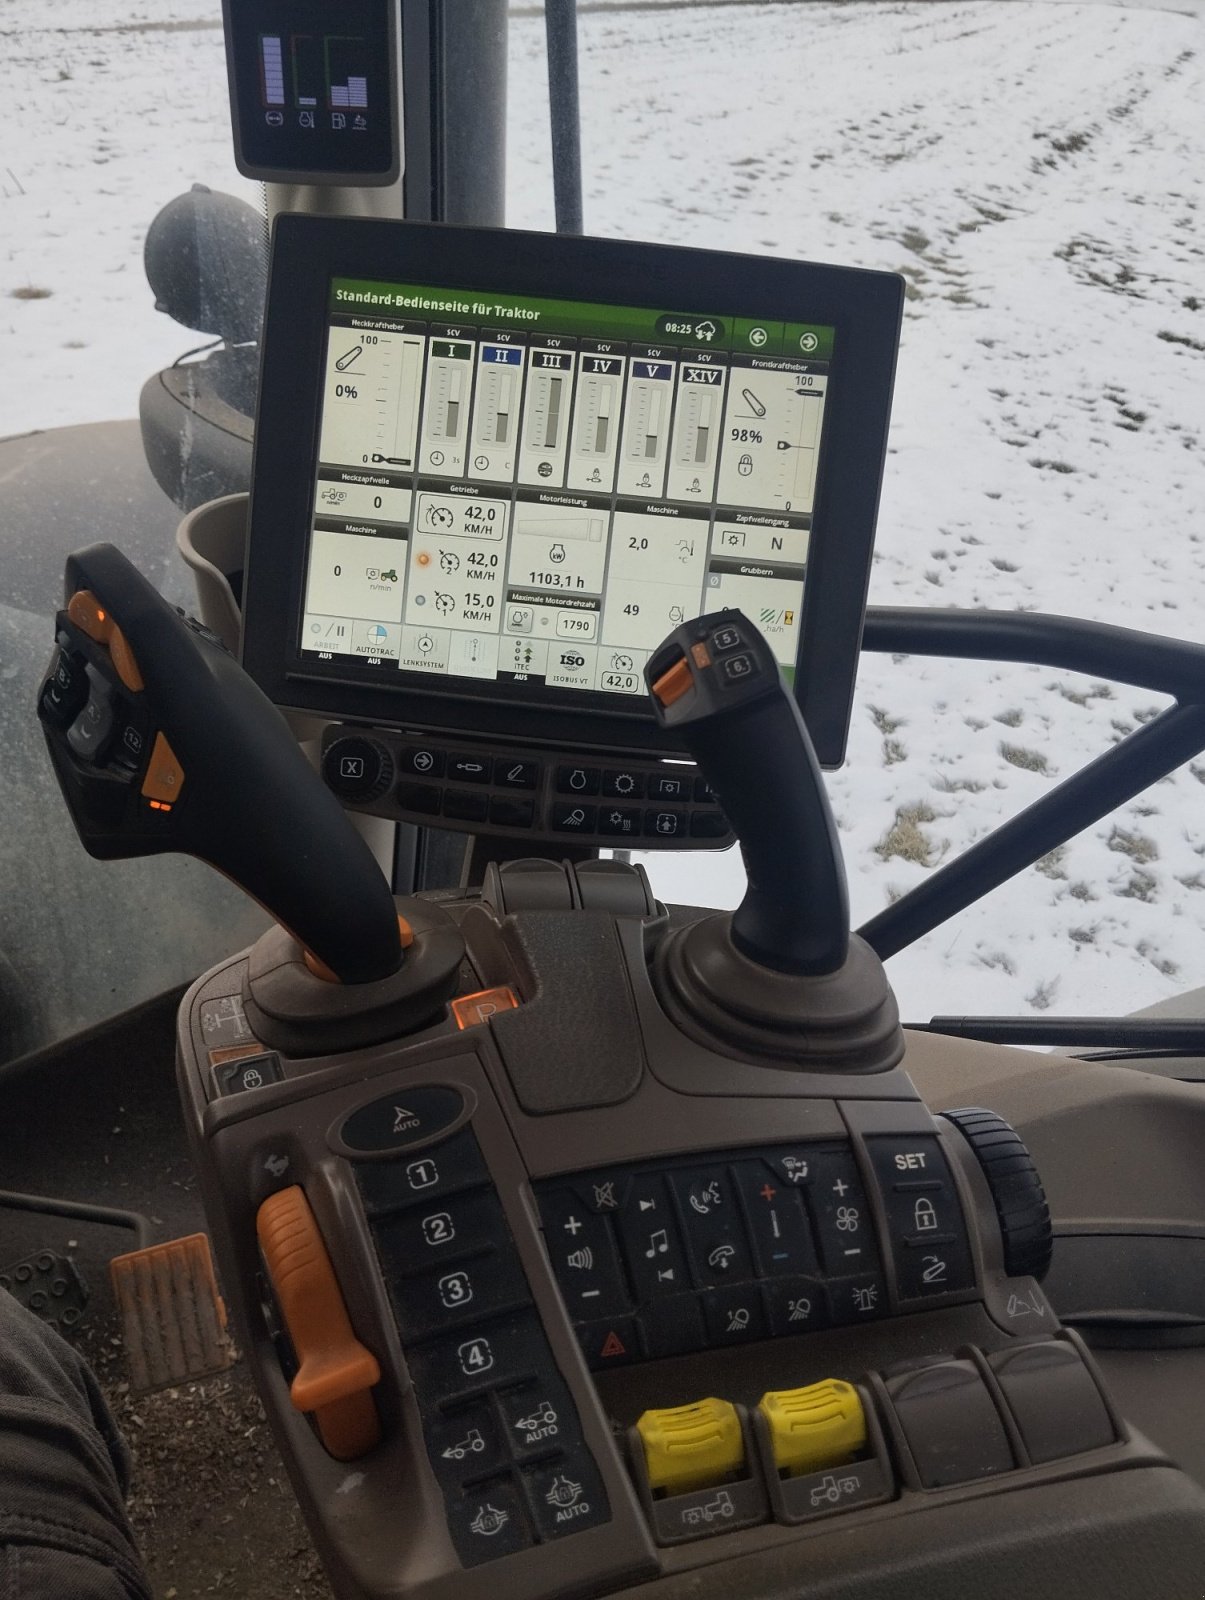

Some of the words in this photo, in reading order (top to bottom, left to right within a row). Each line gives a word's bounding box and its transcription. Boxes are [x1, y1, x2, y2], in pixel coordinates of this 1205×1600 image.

[336, 289, 469, 314] Standard-Bedienseite
[472, 303, 492, 316] für
[495, 306, 540, 320] Traktor
[352, 319, 404, 331] Heckkraftheber
[665, 323, 691, 334] 08:25
[447, 329, 460, 337] SCV
[497, 334, 510, 342] SCV
[360, 335, 378, 345] 100
[547, 339, 561, 347] SCV
[448, 345, 455, 357] I
[598, 344, 611, 352] SCV
[648, 349, 661, 357] SCV
[495, 350, 508, 362] II
[542, 354, 561, 368] III
[698, 354, 711, 362] SCV
[592, 360, 611, 373] IV
[647, 365, 658, 377] V
[752, 360, 808, 372] Frontkraftheber
[687, 370, 719, 384] XIV
[795, 376, 813, 386] 100
[336, 384, 358, 399] 0%
[731, 429, 762, 444] 98%
[362, 455, 368, 464] 0
[342, 473, 390, 485] Heckzapfwelle
[450, 485, 479, 494] Getriebe
[374, 496, 382, 509] 0
[540, 494, 588, 507] Motorleistung
[785, 501, 791, 511] 0
[465, 505, 496, 522] 42,0
[647, 505, 679, 515] Maschine
[736, 514, 789, 527] Zapfwellengang
[345, 525, 377, 534] Maschine
[464, 523, 493, 535] KM/H
[628, 537, 648, 551] 2,0
[772, 537, 782, 550] N
[467, 552, 498, 568] 42,0
[334, 565, 342, 577] 0
[467, 569, 495, 581] KM/H
[740, 566, 773, 576] Grubbern
[529, 572, 571, 588] 1103,1
[577, 576, 584, 588] h
[370, 583, 392, 591] n/min
[464, 593, 494, 609] 15,0
[512, 593, 544, 603] Maximale
[546, 597, 595, 608] Motordrehzahl
[623, 604, 640, 615] 49
[463, 610, 491, 622] KM/H
[563, 620, 589, 631] 1790
[722, 634, 731, 642] 5
[314, 641, 339, 650] ARBEIT
[356, 646, 395, 656] AUTOTRAC
[318, 651, 332, 660] AUS
[367, 656, 381, 665] AUS
[560, 655, 585, 666] ISO
[403, 659, 444, 670] LENKSYSTEM
[553, 676, 578, 684] ISOBUS
[606, 676, 633, 688] 42,0
[128, 732, 138, 746] 12
[347, 761, 357, 773] X
[476, 1003, 496, 1023] P
[393, 1119, 420, 1133] AUTO
[894, 1153, 926, 1170] SET
[416, 1166, 428, 1182] 1
[431, 1220, 446, 1238] 2
[448, 1279, 464, 1300] 3
[468, 1346, 484, 1366] 4
[526, 1424, 558, 1444] AUTO
[556, 1503, 589, 1522] AUTO
